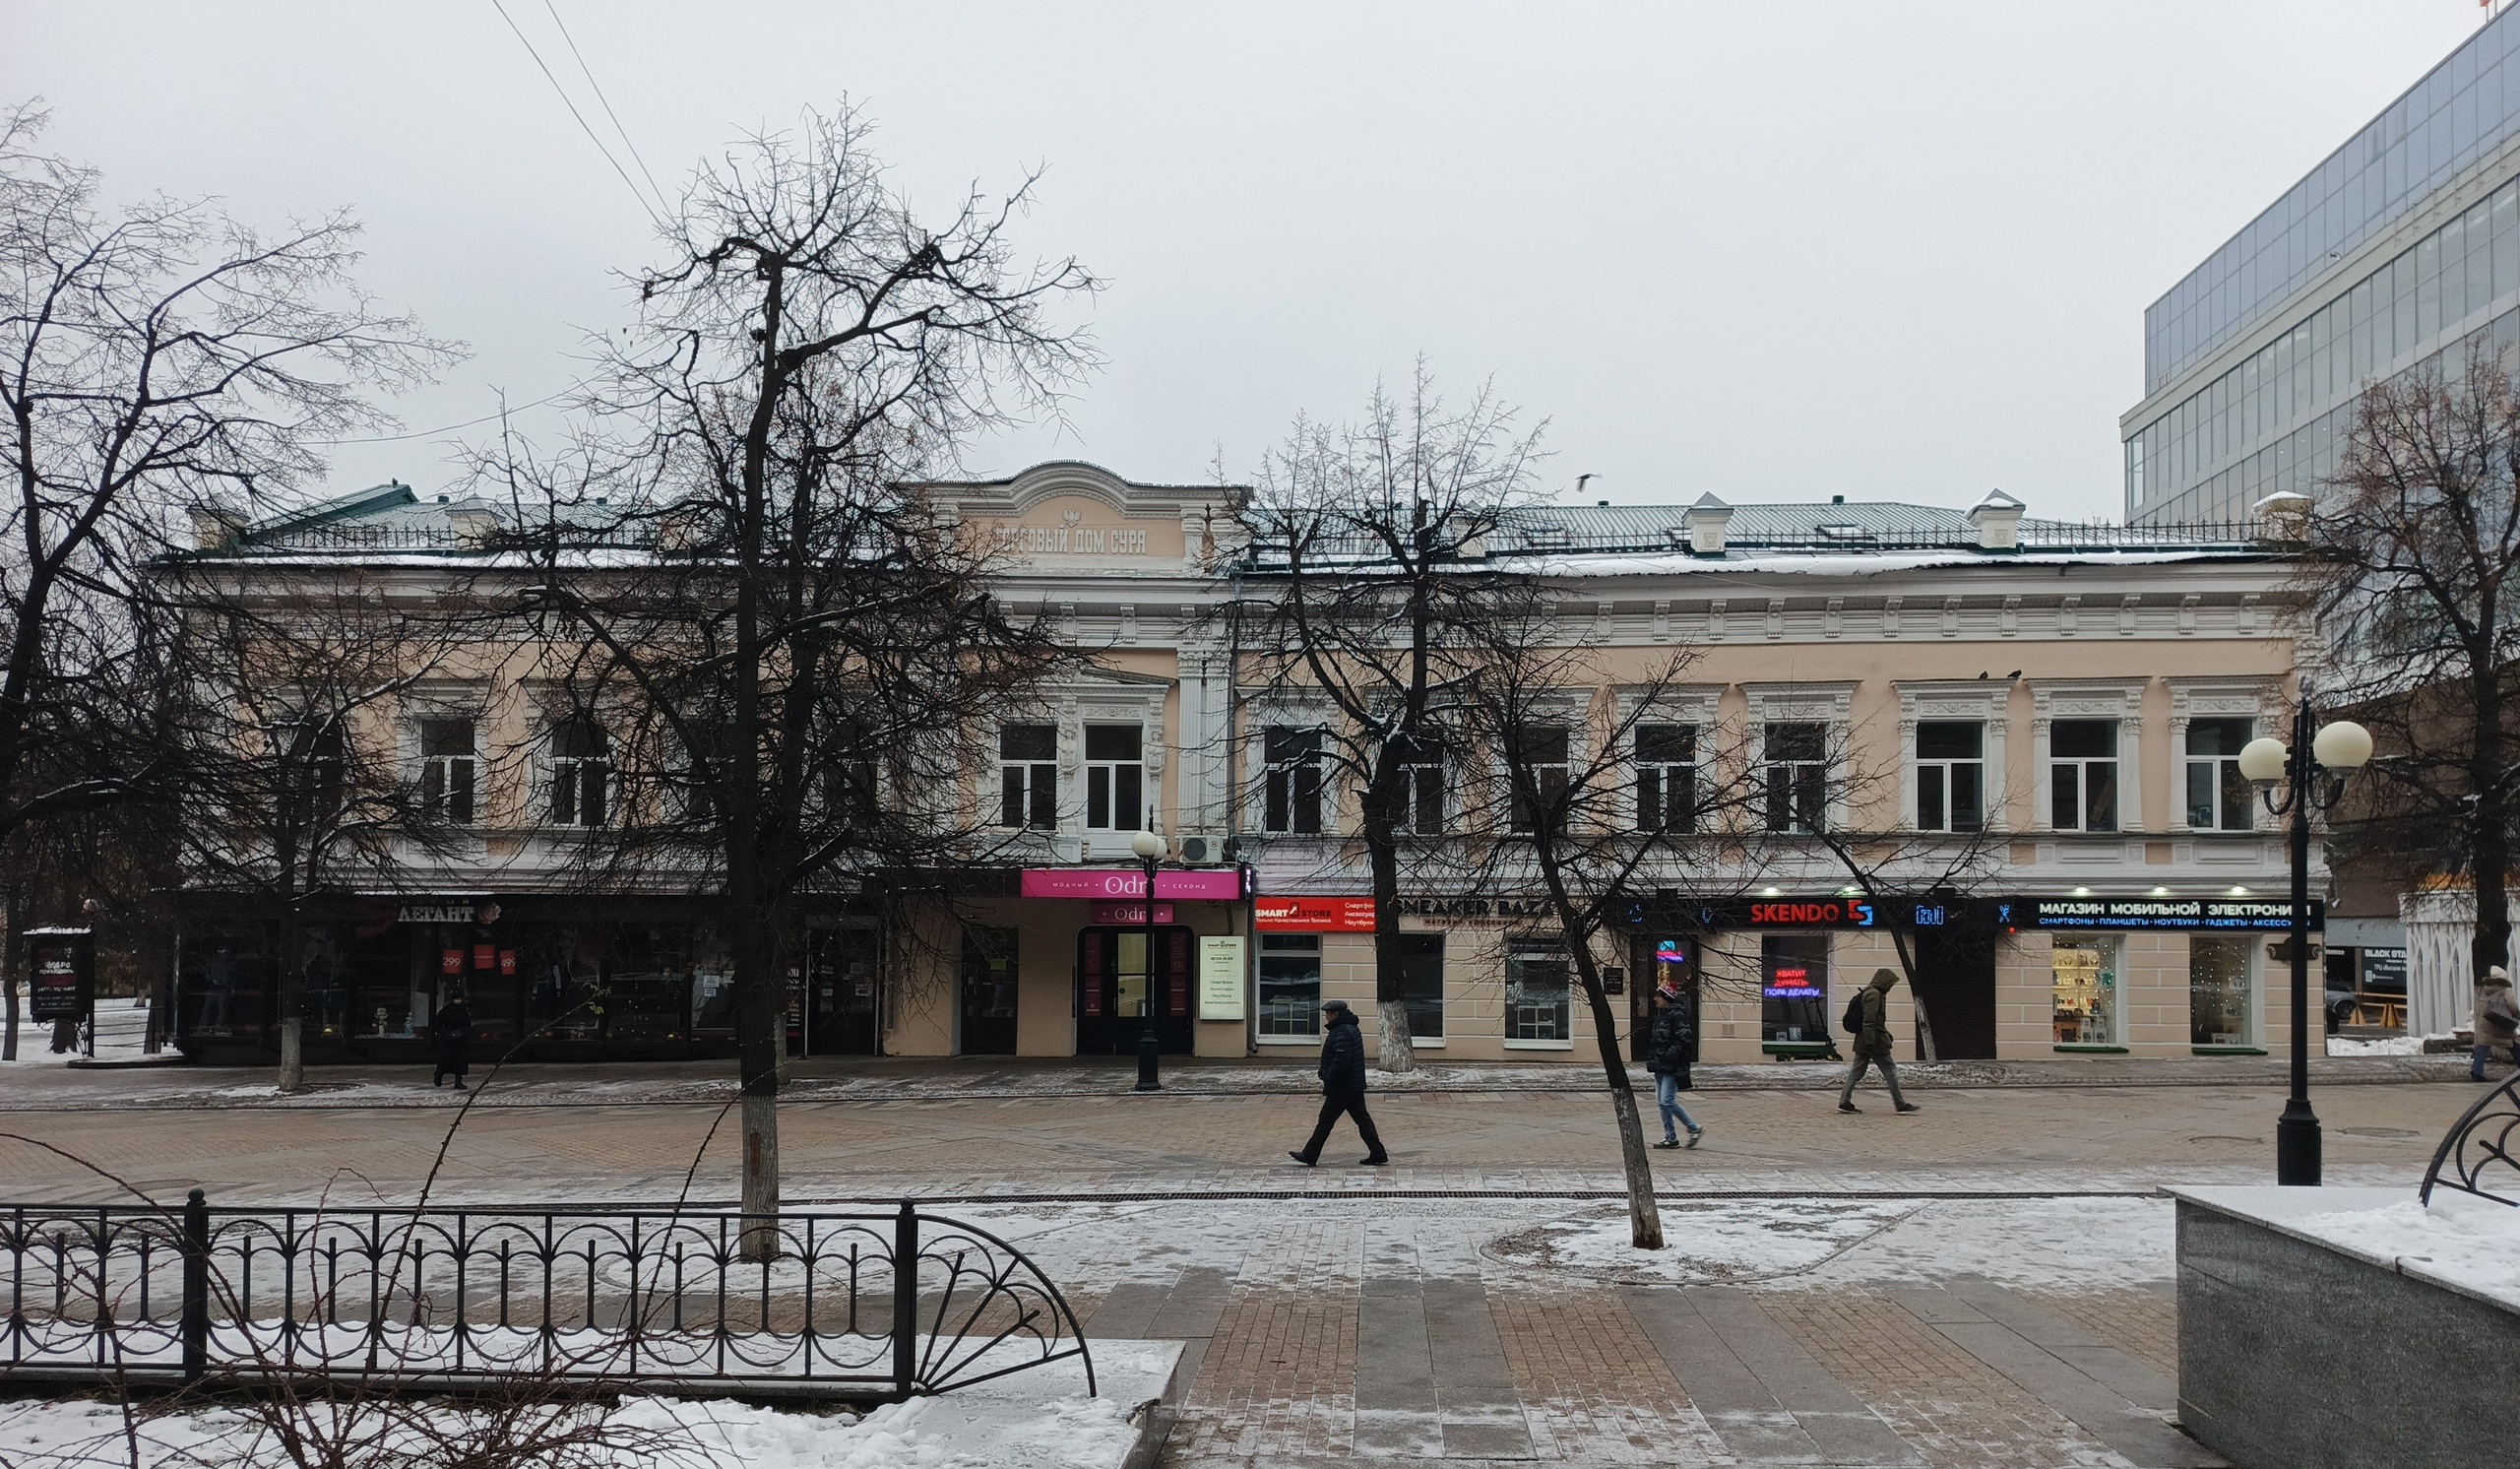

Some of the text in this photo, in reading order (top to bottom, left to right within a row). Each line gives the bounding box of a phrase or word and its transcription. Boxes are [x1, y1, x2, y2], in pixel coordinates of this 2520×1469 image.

[994, 524, 1148, 554] ТОРГОВЫЙ ДОМ СУРА
[1104, 875, 1154, 894] Odr
[1254, 909, 1289, 918] SMART
[1751, 903, 1840, 924] SKENDO
[2039, 900, 2311, 917] МАГАЗИН МОБИЛЬНОЙ ЭЛЕКТРОНИ
[2038, 917, 2095, 926] СМАРТФОНЫ
[2099, 917, 2150, 926] ПЛАНШЕТЫ
[2153, 918, 2201, 926] НОУТБУКИ
[2205, 918, 2250, 927] ГАДЖЕТЫ
[2364, 948, 2407, 959] BLACK STA
[443, 958, 462, 968] 299
